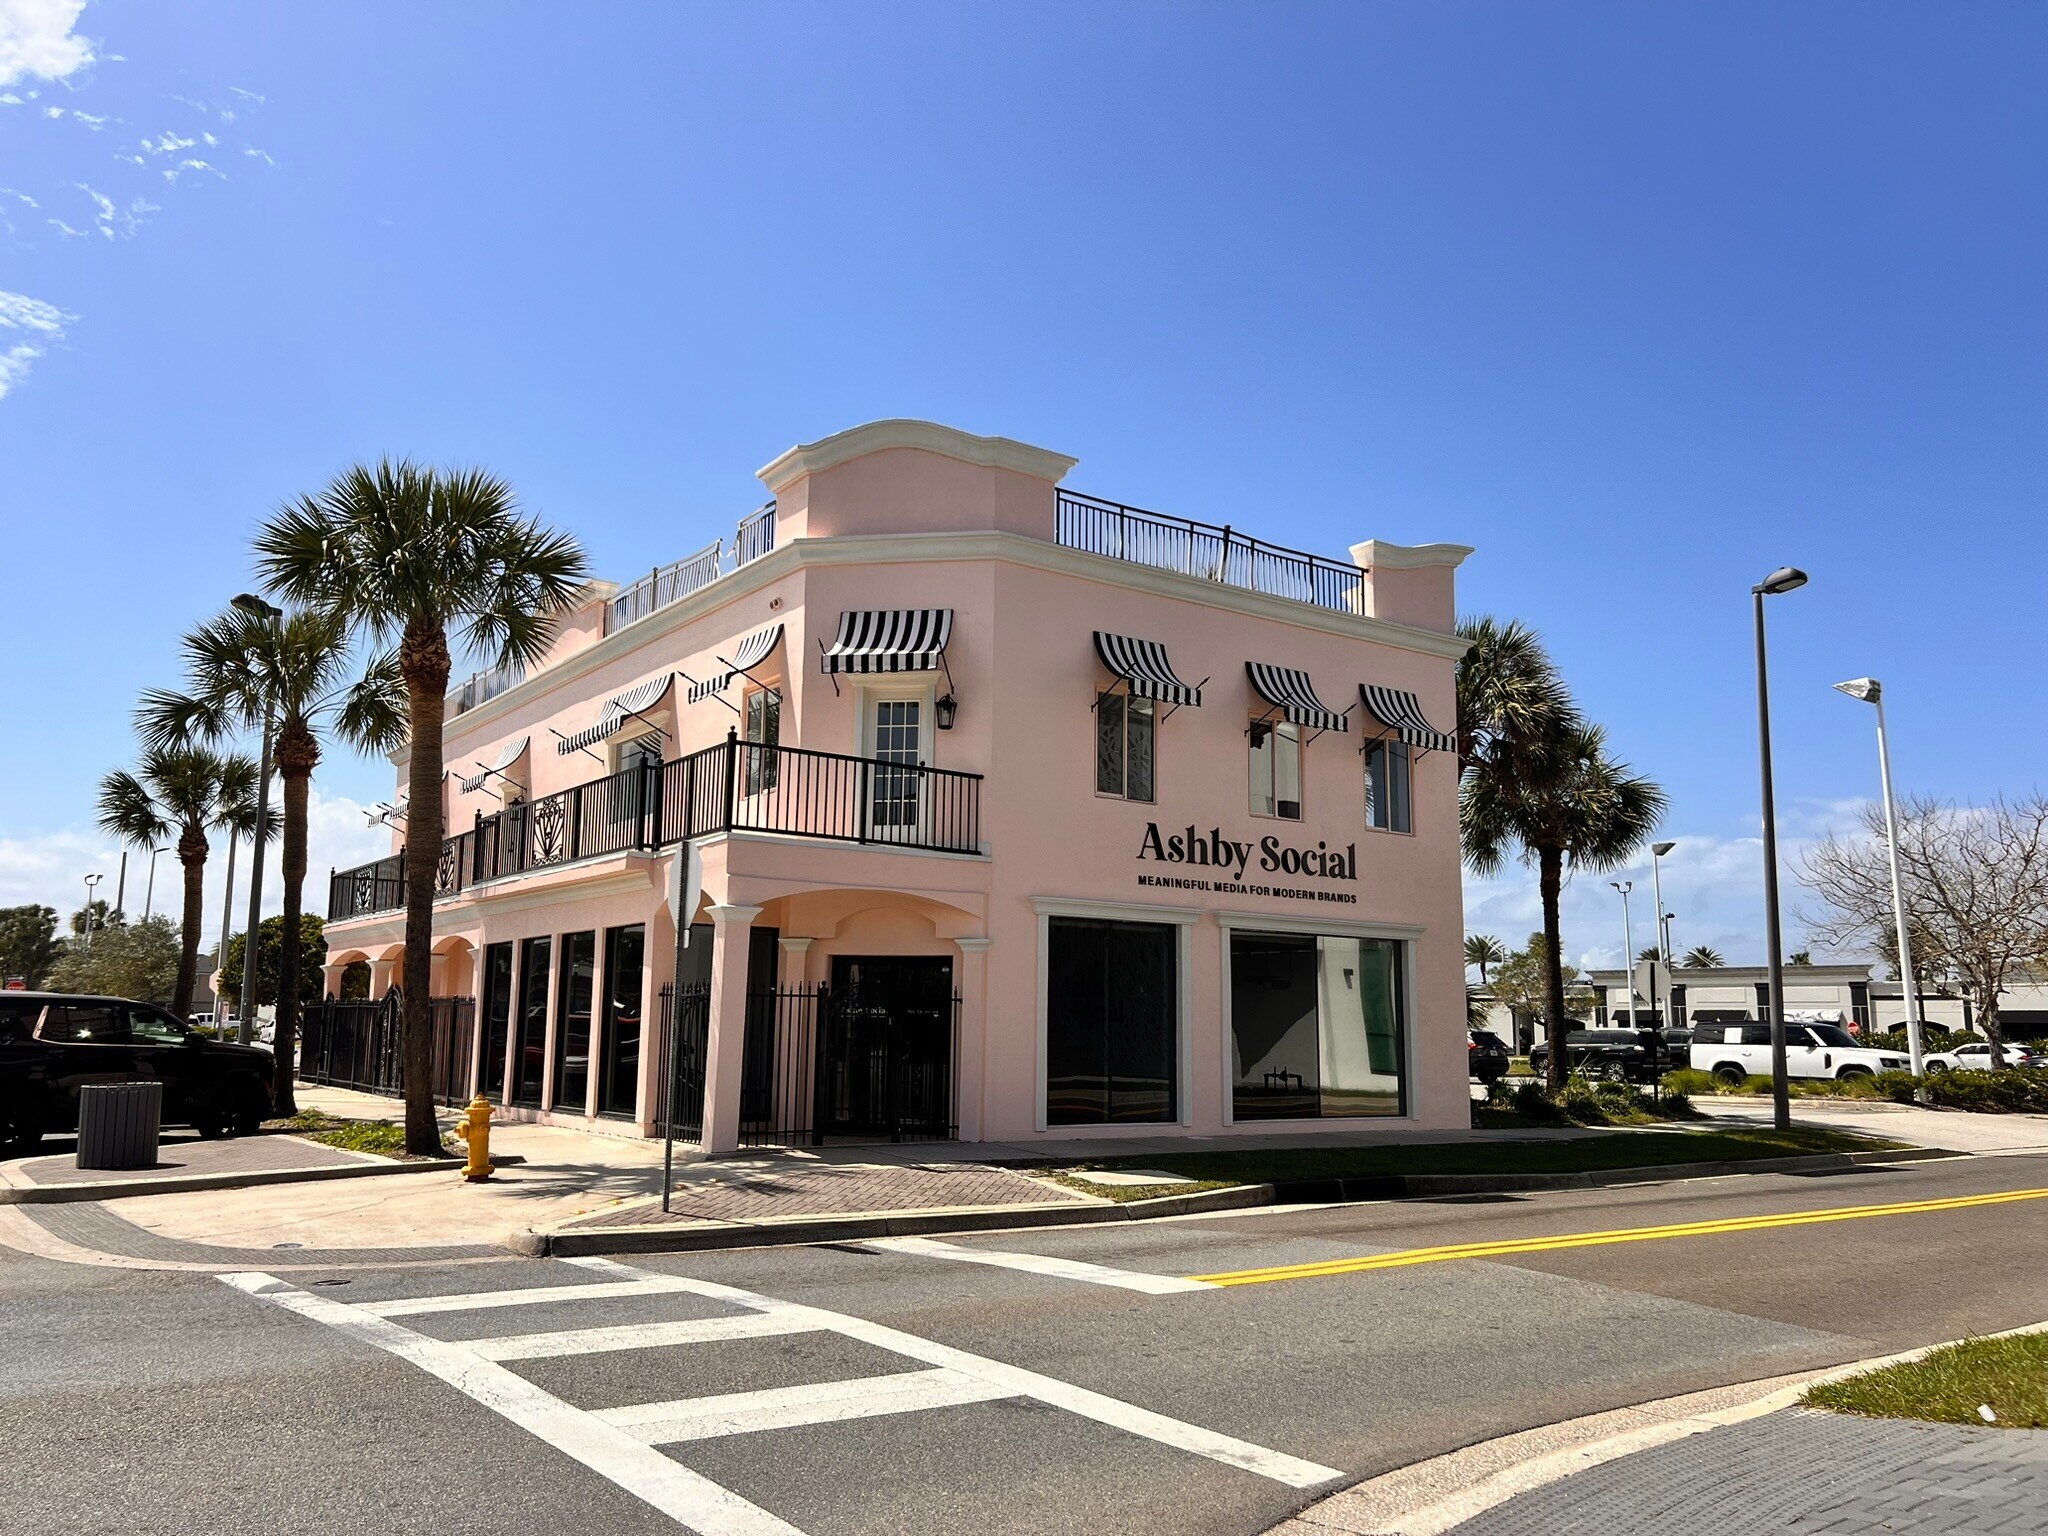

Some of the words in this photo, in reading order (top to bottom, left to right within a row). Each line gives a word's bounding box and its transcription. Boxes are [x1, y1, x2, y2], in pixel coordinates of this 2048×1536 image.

[1136, 822, 1254, 881] Ashby
[1260, 835, 1358, 880] Social
[1138, 875, 1212, 891] MEANINGFUL
[1213, 882, 1248, 894] MEDIA
[1250, 885, 1270, 897] FOR
[1273, 888, 1316, 901] MODERN
[1318, 892, 1357, 904] BRANDS
